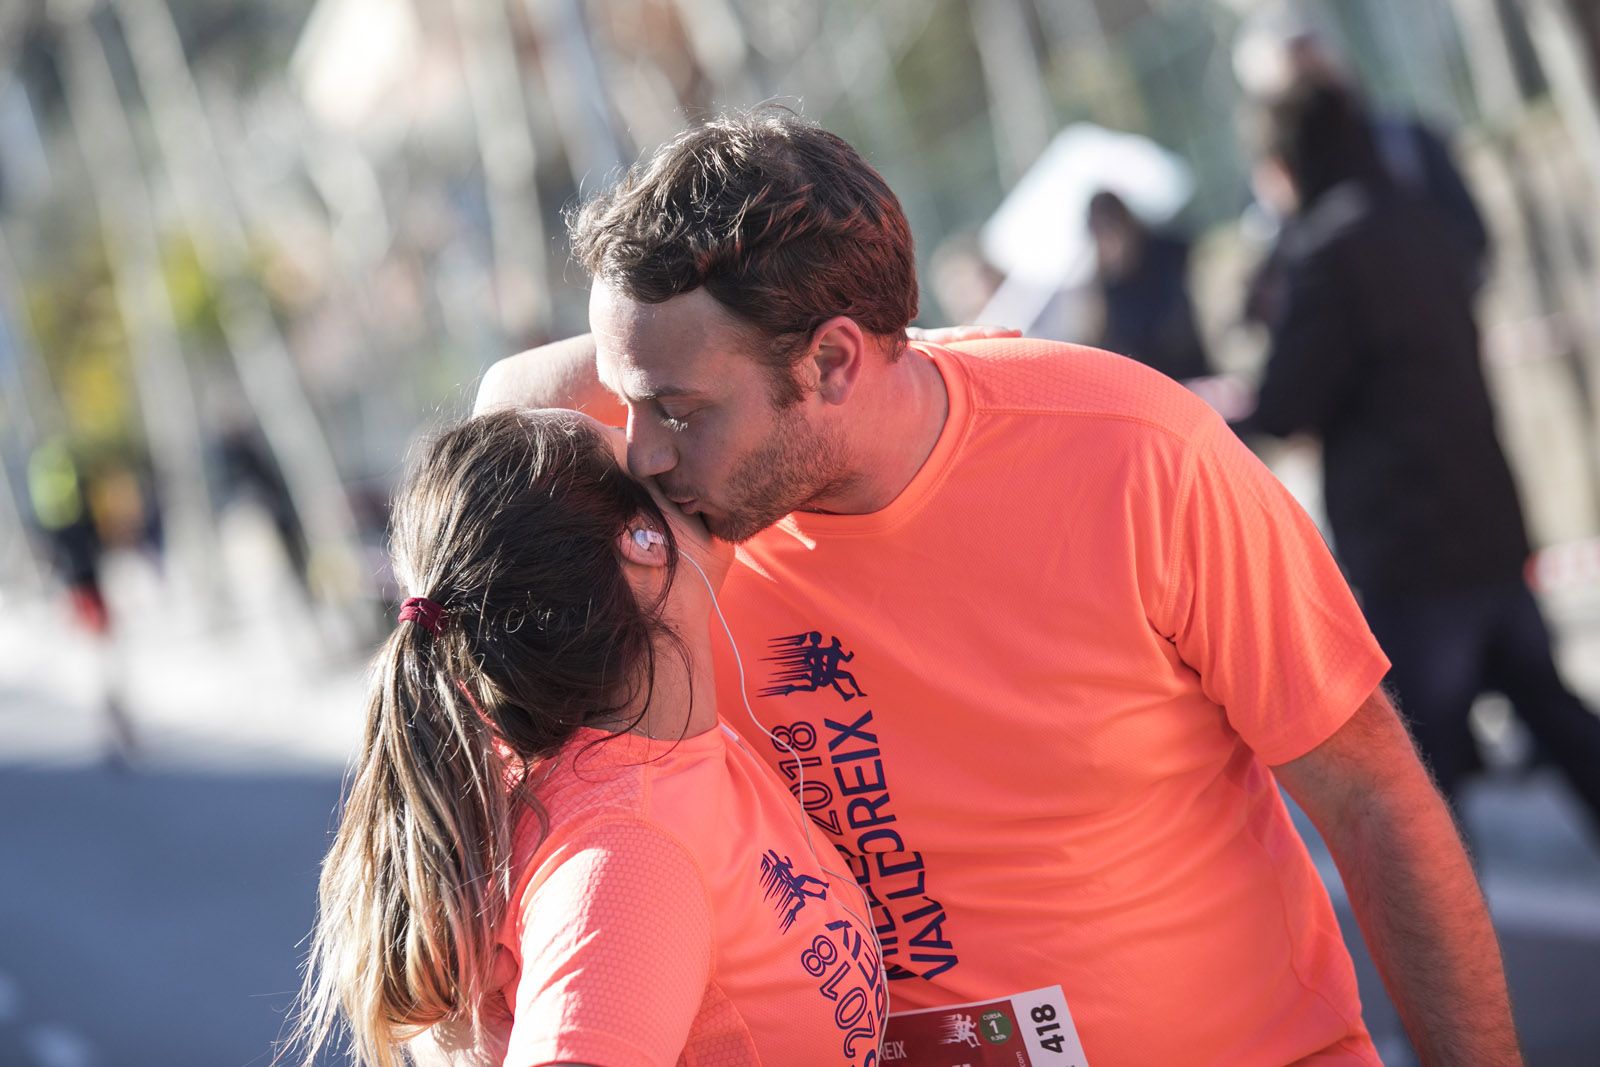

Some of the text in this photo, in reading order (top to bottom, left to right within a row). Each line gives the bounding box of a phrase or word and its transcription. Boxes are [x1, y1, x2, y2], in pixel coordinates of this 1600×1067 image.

[771, 721, 843, 836] 2018
[801, 935, 876, 1059] 2018
[989, 1020, 999, 1034] 1
[1030, 1003, 1066, 1054] 418
